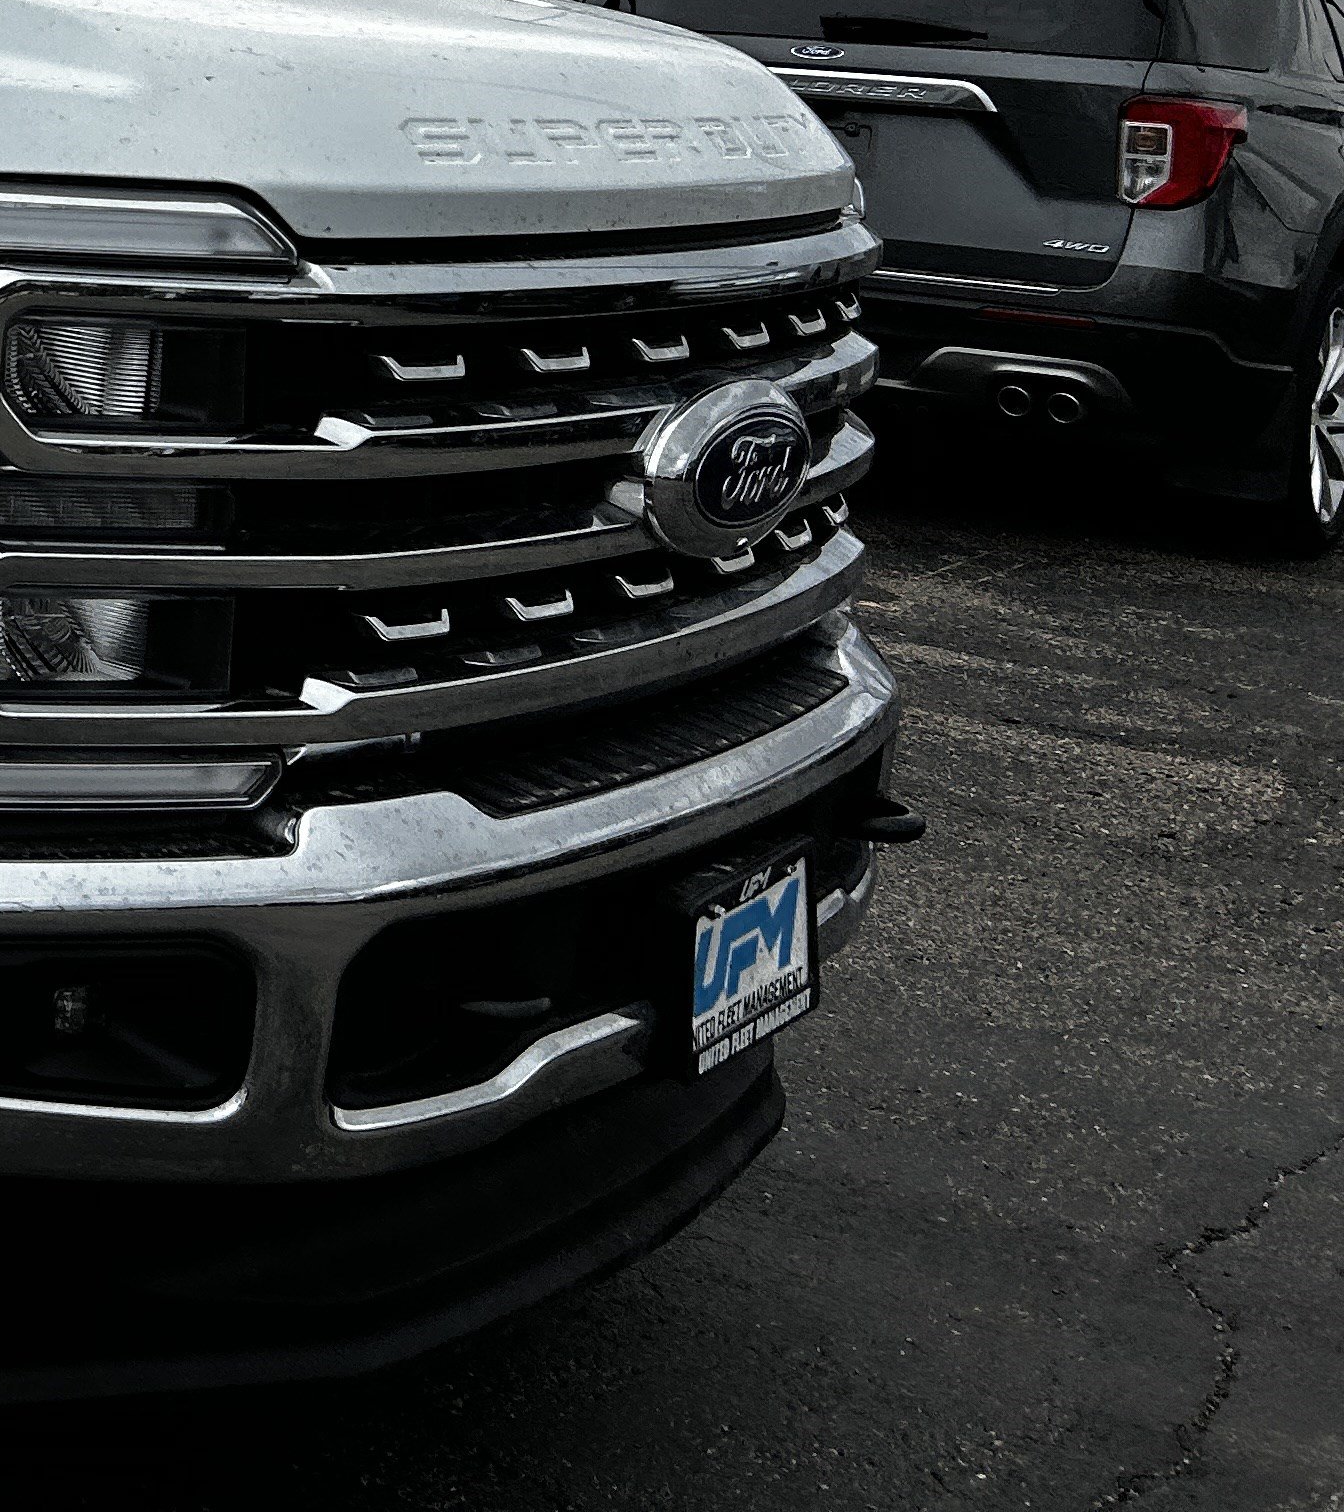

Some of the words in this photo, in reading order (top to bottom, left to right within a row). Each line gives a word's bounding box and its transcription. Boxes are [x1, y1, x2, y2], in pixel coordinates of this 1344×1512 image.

[801, 44, 833, 56] Ford
[790, 79, 927, 99] LORER
[398, 115, 698, 166] SUPER
[1042, 239, 1111, 253] 4WD
[721, 433, 796, 509] Ford
[693, 877, 801, 1018] UFM
[743, 966, 804, 1018] MANAGEMENT
